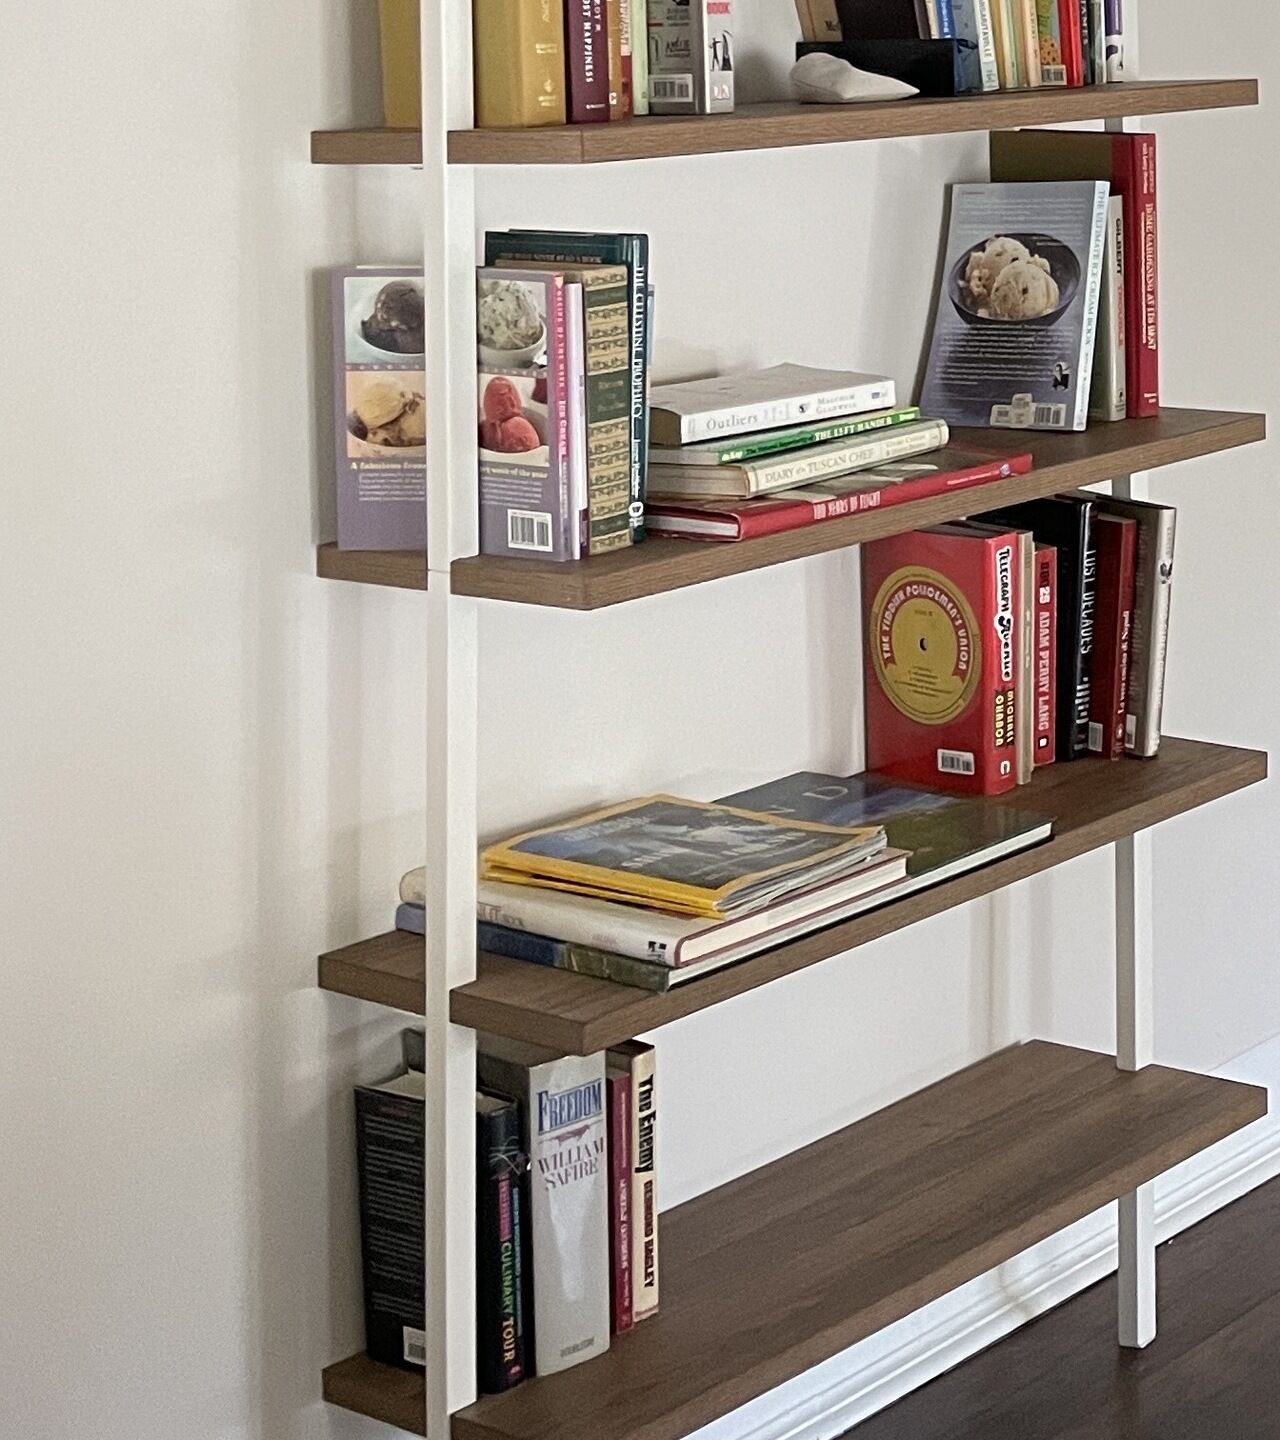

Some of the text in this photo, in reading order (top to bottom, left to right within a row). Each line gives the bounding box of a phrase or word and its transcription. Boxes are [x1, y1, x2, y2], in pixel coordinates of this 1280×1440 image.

[593, 0, 601, 20] ROY
[582, 21, 593, 83] HAPPINESS
[1096, 190, 1106, 207] THE
[1092, 208, 1104, 260] ULTIMATE
[1145, 204, 1154, 234] HOME
[633, 266, 645, 289] THE
[1145, 235, 1155, 291] GARDENING
[1087, 280, 1098, 315] CREAM
[632, 293, 644, 354] CELESTINE
[1084, 318, 1095, 346] BOOK
[632, 359, 643, 419] PROPHECY
[559, 419, 567, 456] CREAM
[706, 413, 758, 431] Outliers
[814, 431, 833, 441] THE
[765, 448, 874, 483] DIARY TUSCAN CHEF
[814, 502, 826, 520] 100
[828, 499, 848, 516] YEARS
[859, 491, 880, 510] FLIGHT
[998, 549, 1010, 612] TELEGRAPH
[882, 584, 969, 670] THE YIDDISH POLICEMEN'S UNION
[1039, 612, 1050, 648] ADAM
[1038, 651, 1050, 694] PERRY
[995, 695, 1004, 747] CHABON
[1006, 690, 1014, 742] MICHAEL
[1038, 697, 1049, 731] LANG
[1117, 702, 1125, 714] La
[536, 1082, 602, 1131] FREEDOM
[638, 1074, 654, 1112] The
[539, 1137, 603, 1174] WILLIAM
[635, 1111, 656, 1174] Enemy
[545, 1157, 598, 1191] SAFIRE
[500, 1241, 514, 1314] CULINARY
[502, 1317, 516, 1362] TOUR
